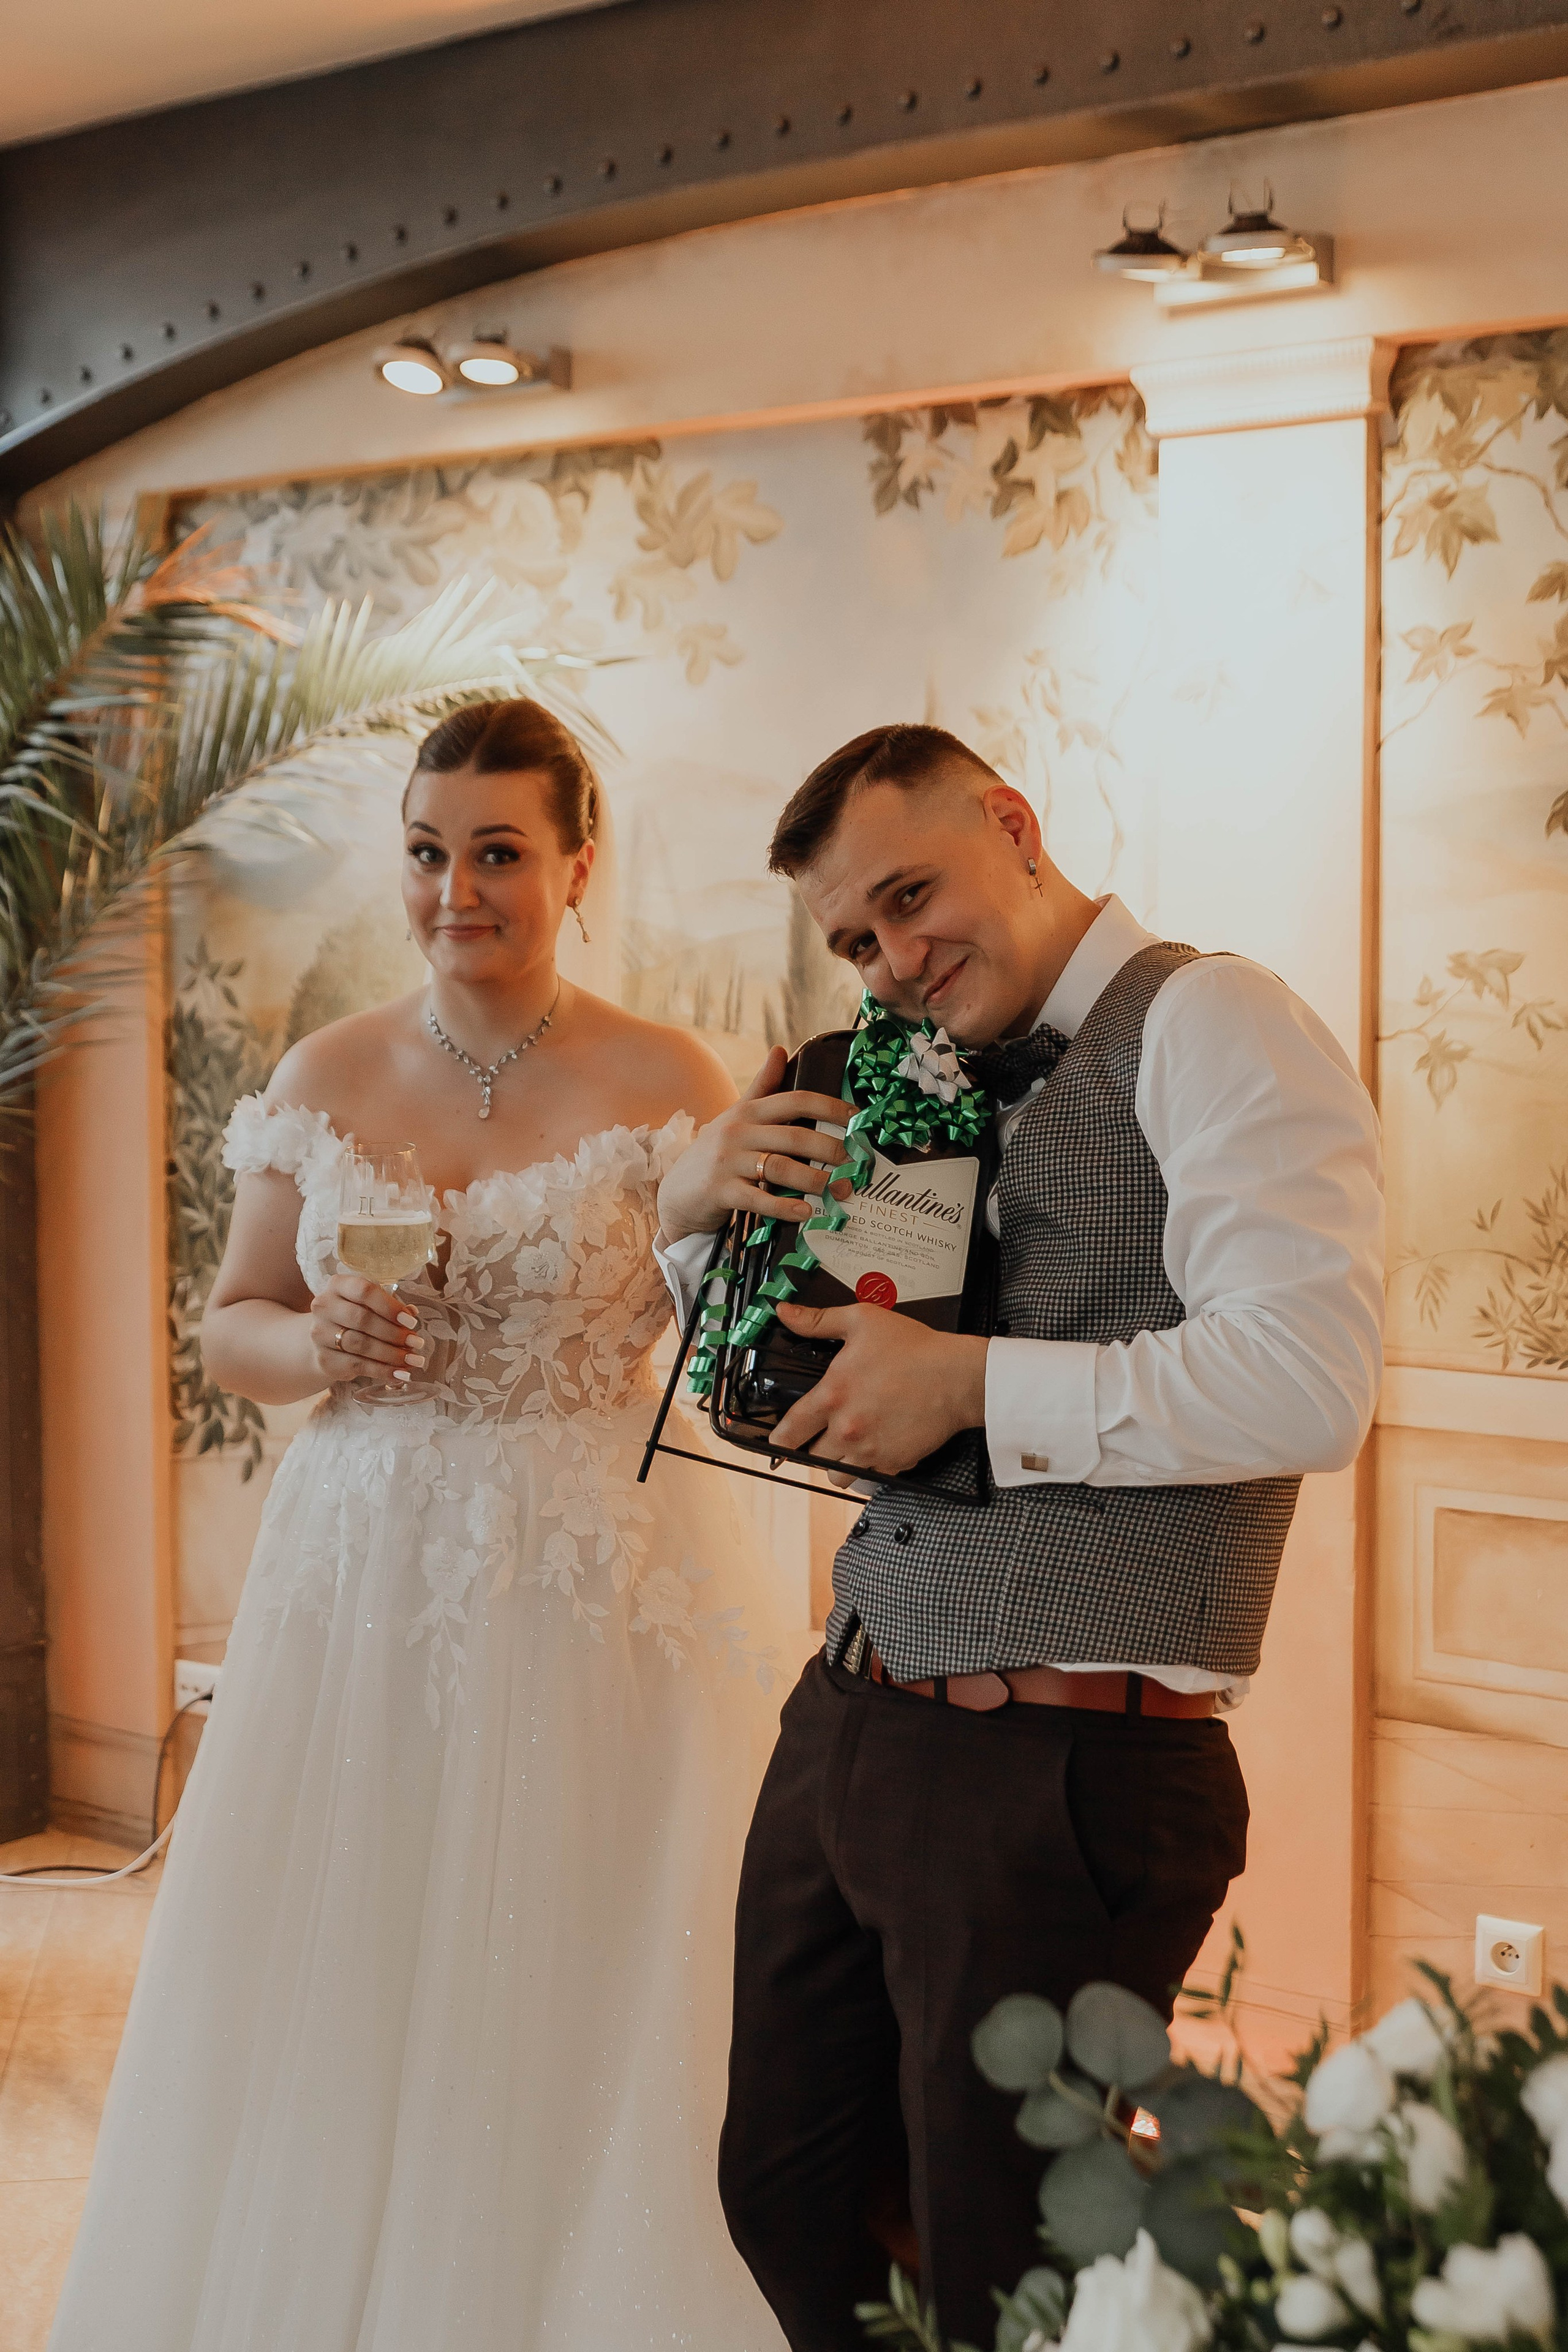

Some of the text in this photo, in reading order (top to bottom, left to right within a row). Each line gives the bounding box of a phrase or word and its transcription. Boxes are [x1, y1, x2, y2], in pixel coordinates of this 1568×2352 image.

[853, 1171, 965, 1224] allantine's
[859, 1201, 919, 1226] FINEST
[815, 1207, 957, 1252] BLDED SCOTCH WHISKY
[870, 1231, 896, 1242] BOTTLED
[859, 1236, 903, 1251] BALLANTINE
[886, 1258, 916, 1270] SCOTLAND
[904, 1254, 940, 1269] SCOTLAND
